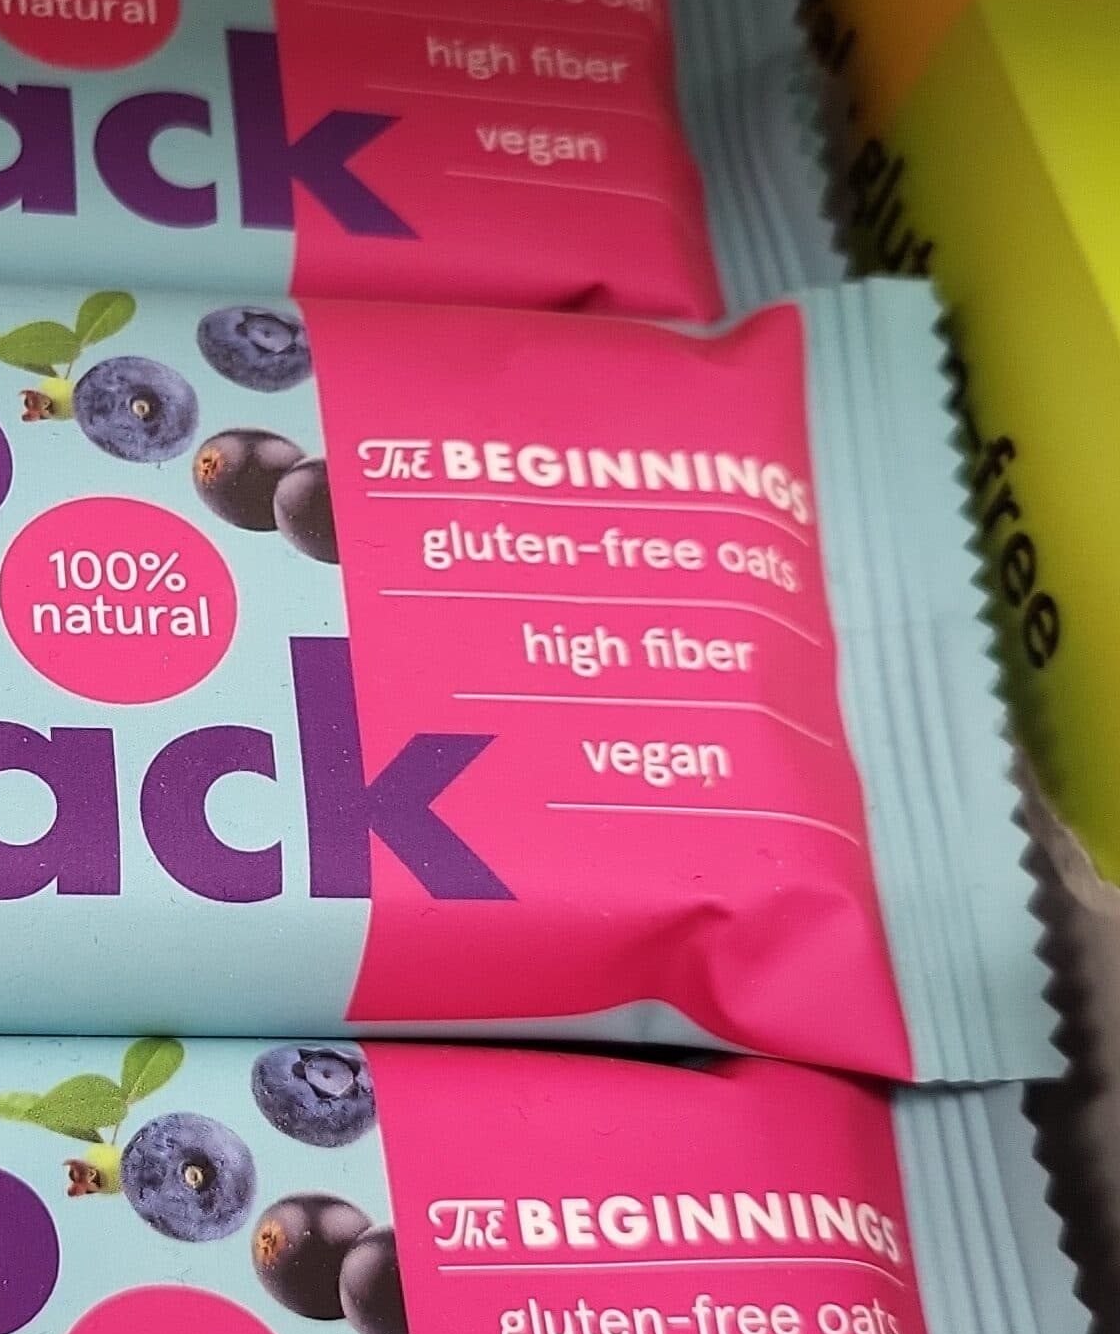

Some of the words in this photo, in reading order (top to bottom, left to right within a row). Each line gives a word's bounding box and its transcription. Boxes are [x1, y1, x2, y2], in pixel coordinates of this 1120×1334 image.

[427, 34, 517, 80] high
[531, 45, 629, 83] fiber
[476, 122, 604, 166] vegan
[357, 439, 433, 482] The
[442, 440, 811, 526] BEGINNINGS
[48, 550, 187, 593] 100%
[421, 525, 704, 572] gluten-free
[717, 537, 798, 593] oats
[31, 594, 212, 638] natural
[521, 623, 629, 677] high
[641, 628, 756, 673] fiber
[582, 734, 729, 788] vegan
[428, 1199, 507, 1250] The
[517, 1191, 901, 1264] BEGINNINGS
